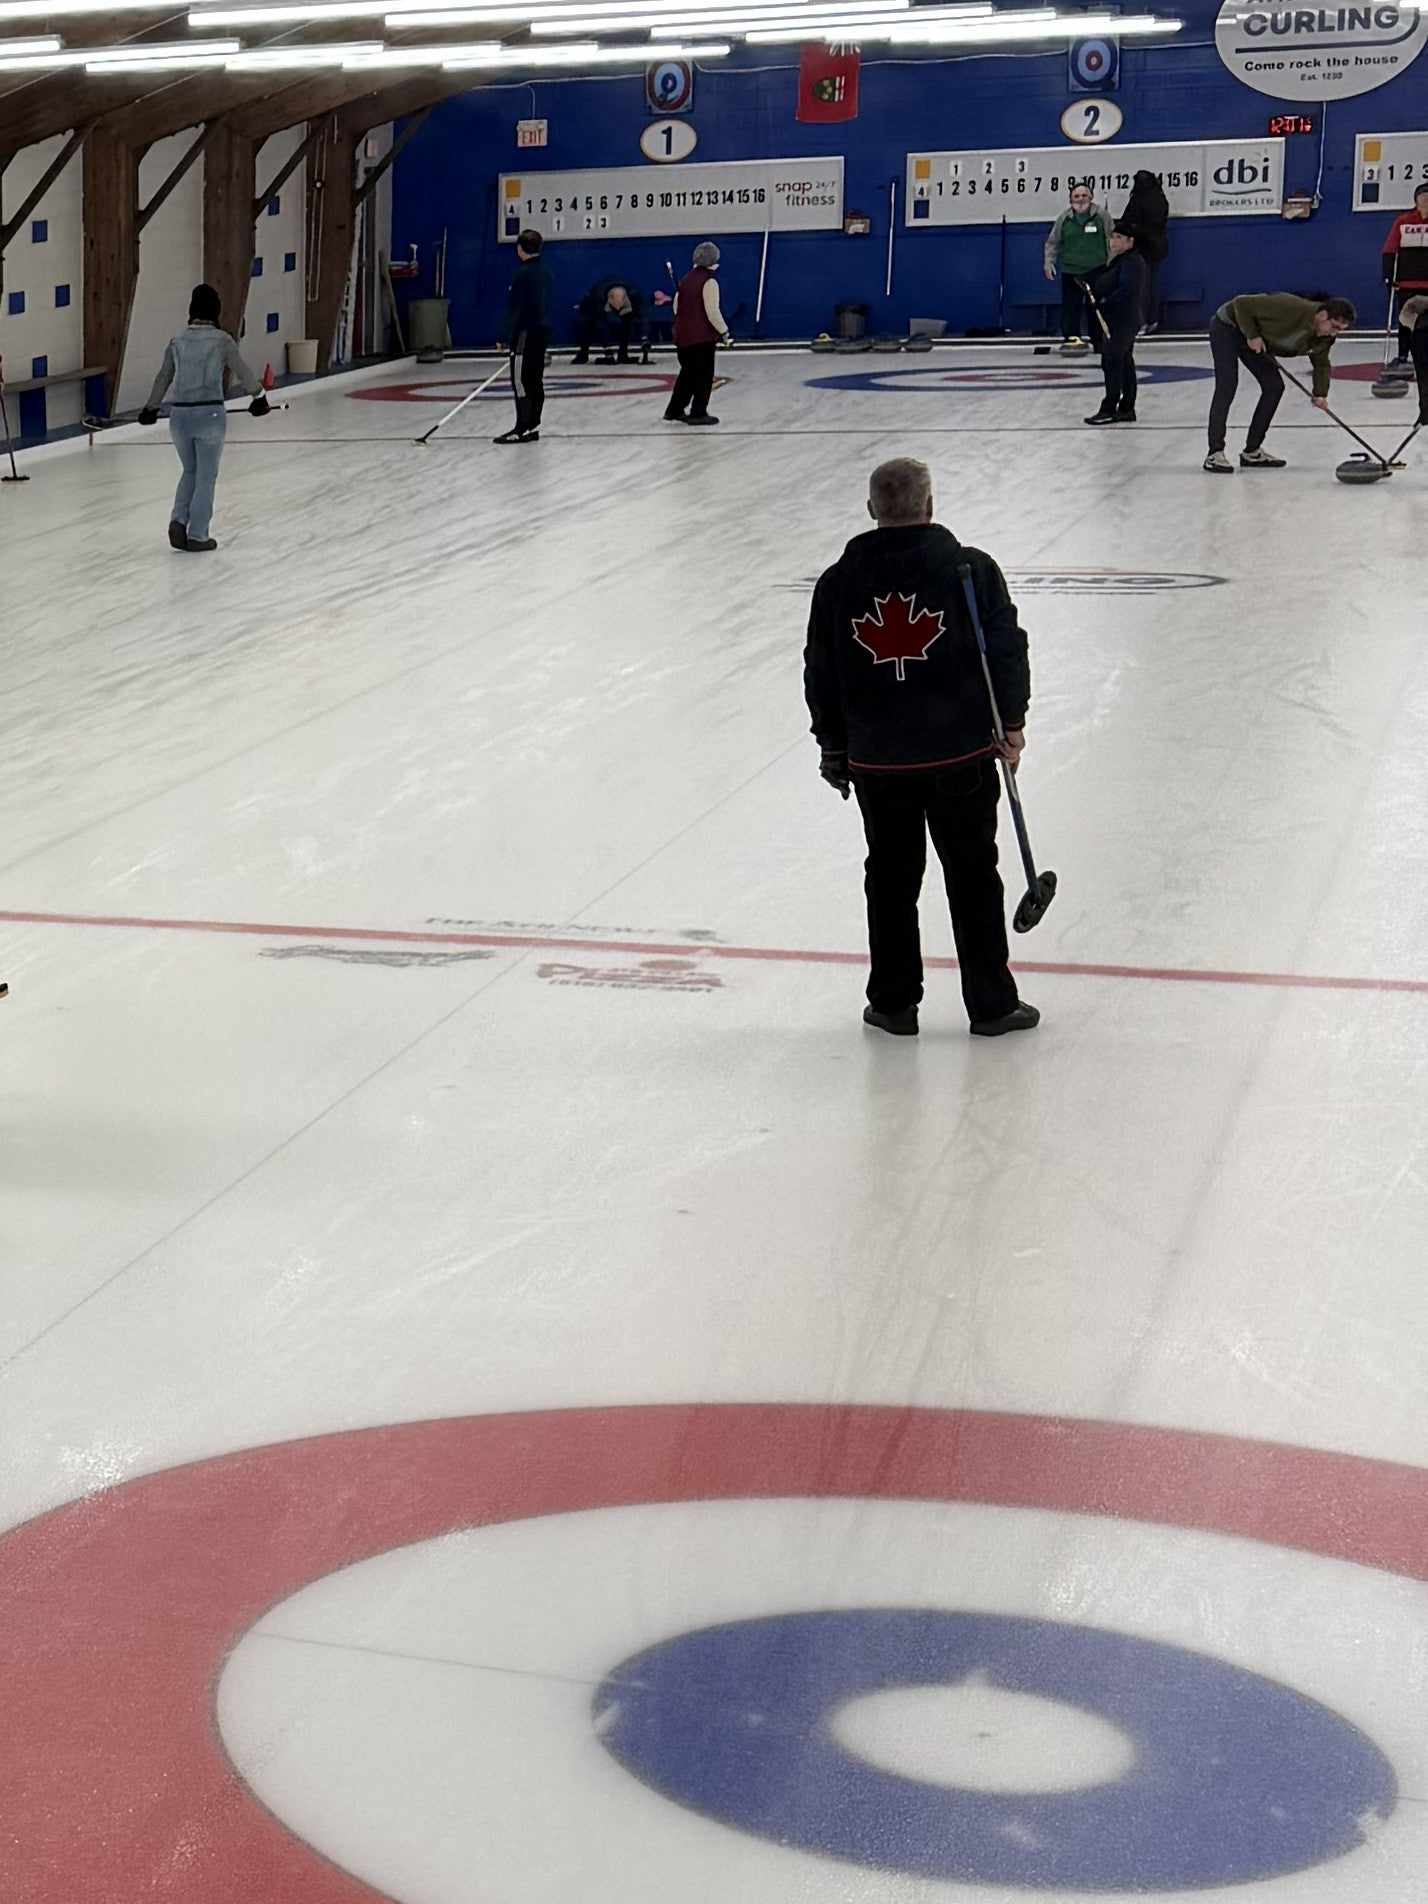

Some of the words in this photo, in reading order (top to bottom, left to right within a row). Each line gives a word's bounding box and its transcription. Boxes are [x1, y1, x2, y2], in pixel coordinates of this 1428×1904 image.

[1244, 5, 1399, 36] CURLING
[1245, 60, 1284, 71] Come
[1289, 58, 1321, 68] rock
[1326, 56, 1350, 67] the
[1354, 55, 1399, 65] house
[1084, 105, 1100, 136] 2
[661, 125, 673, 155] 1
[1213, 156, 1270, 185] dbi
[1388, 165, 1394, 180] 1
[1404, 164, 1413, 179] 2
[774, 180, 813, 194] snap
[937, 182, 943, 196] 1
[952, 181, 960, 195] 2
[968, 180, 976, 194] 3
[984, 179, 993, 194] 4
[1001, 179, 1009, 193] 5
[1017, 178, 1025, 193] 6
[1034, 177, 1042, 192] 7
[1050, 177, 1058, 191] 8
[1100, 175, 1112, 190] 11
[1115, 174, 1129, 189] 12
[1167, 173, 1181, 187] 15
[1184, 171, 1198, 186] 16
[526, 199, 532, 214] 1
[540, 198, 547, 213] 2
[555, 197, 563, 212] 3
[570, 197, 578, 211] 4
[585, 196, 593, 211] 5
[600, 196, 608, 210] 6
[615, 195, 623, 210] 7
[631, 194, 639, 209] 8
[646, 193, 654, 208] 9
[659, 193, 672, 207] 10
[675, 192, 687, 206] 11
[690, 191, 703, 206] 12
[706, 190, 719, 205] 13
[721, 189, 734, 204] 14
[737, 189, 750, 204] 15
[752, 188, 766, 203] 16
[785, 193, 835, 206] fitness
